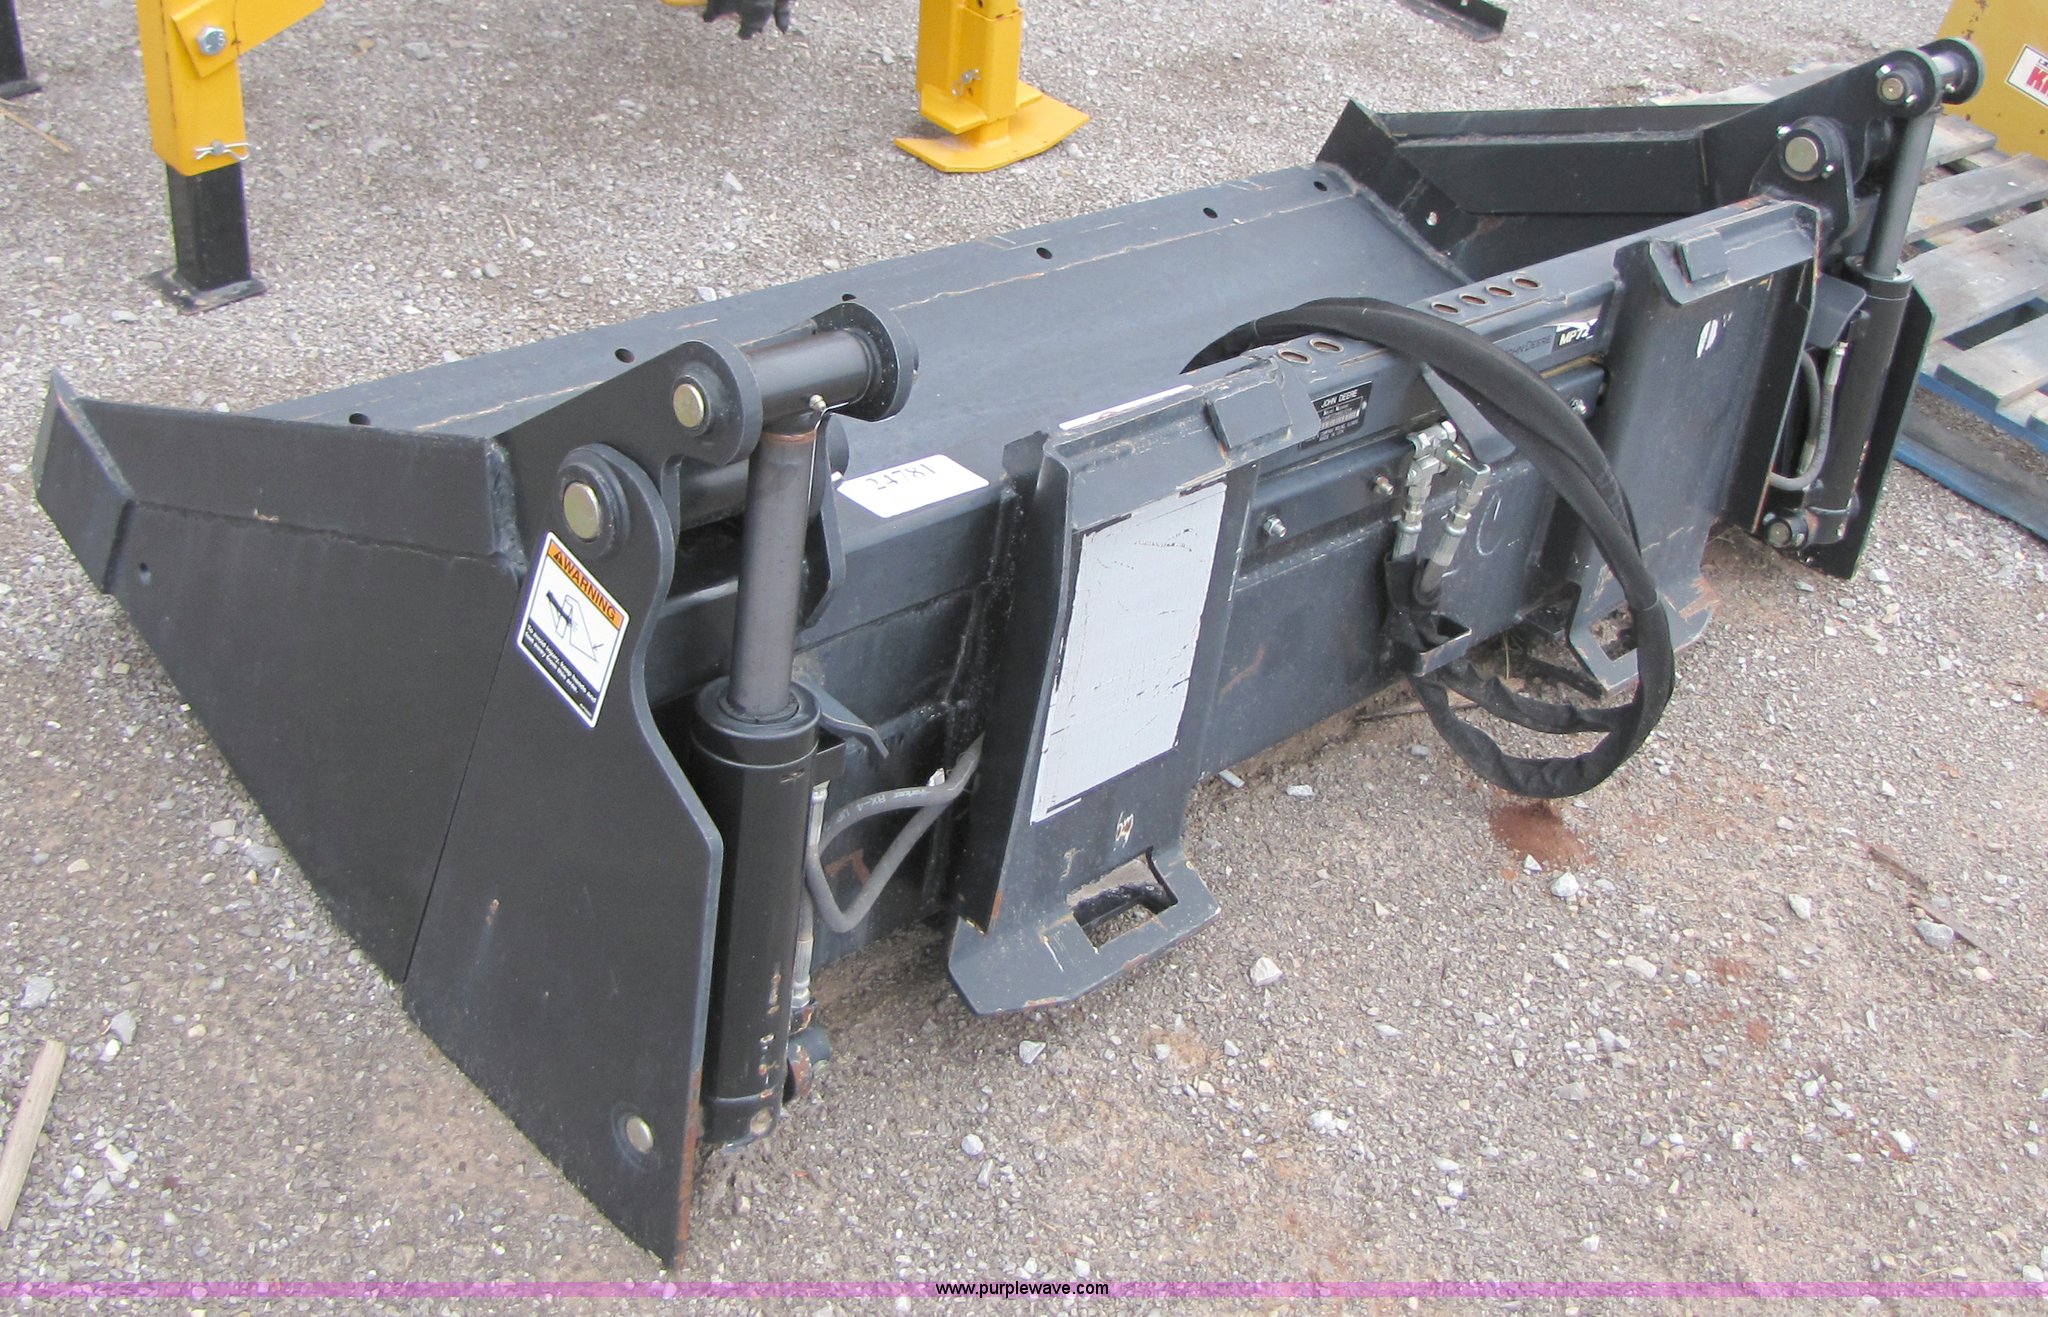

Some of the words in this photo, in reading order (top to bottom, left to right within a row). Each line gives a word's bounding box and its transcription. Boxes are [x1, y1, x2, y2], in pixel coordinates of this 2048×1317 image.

[1321, 396, 1338, 408] JOHN
[1338, 389, 1359, 402] DEERE
[865, 463, 936, 490] 24781
[561, 558, 616, 622] WARNING
